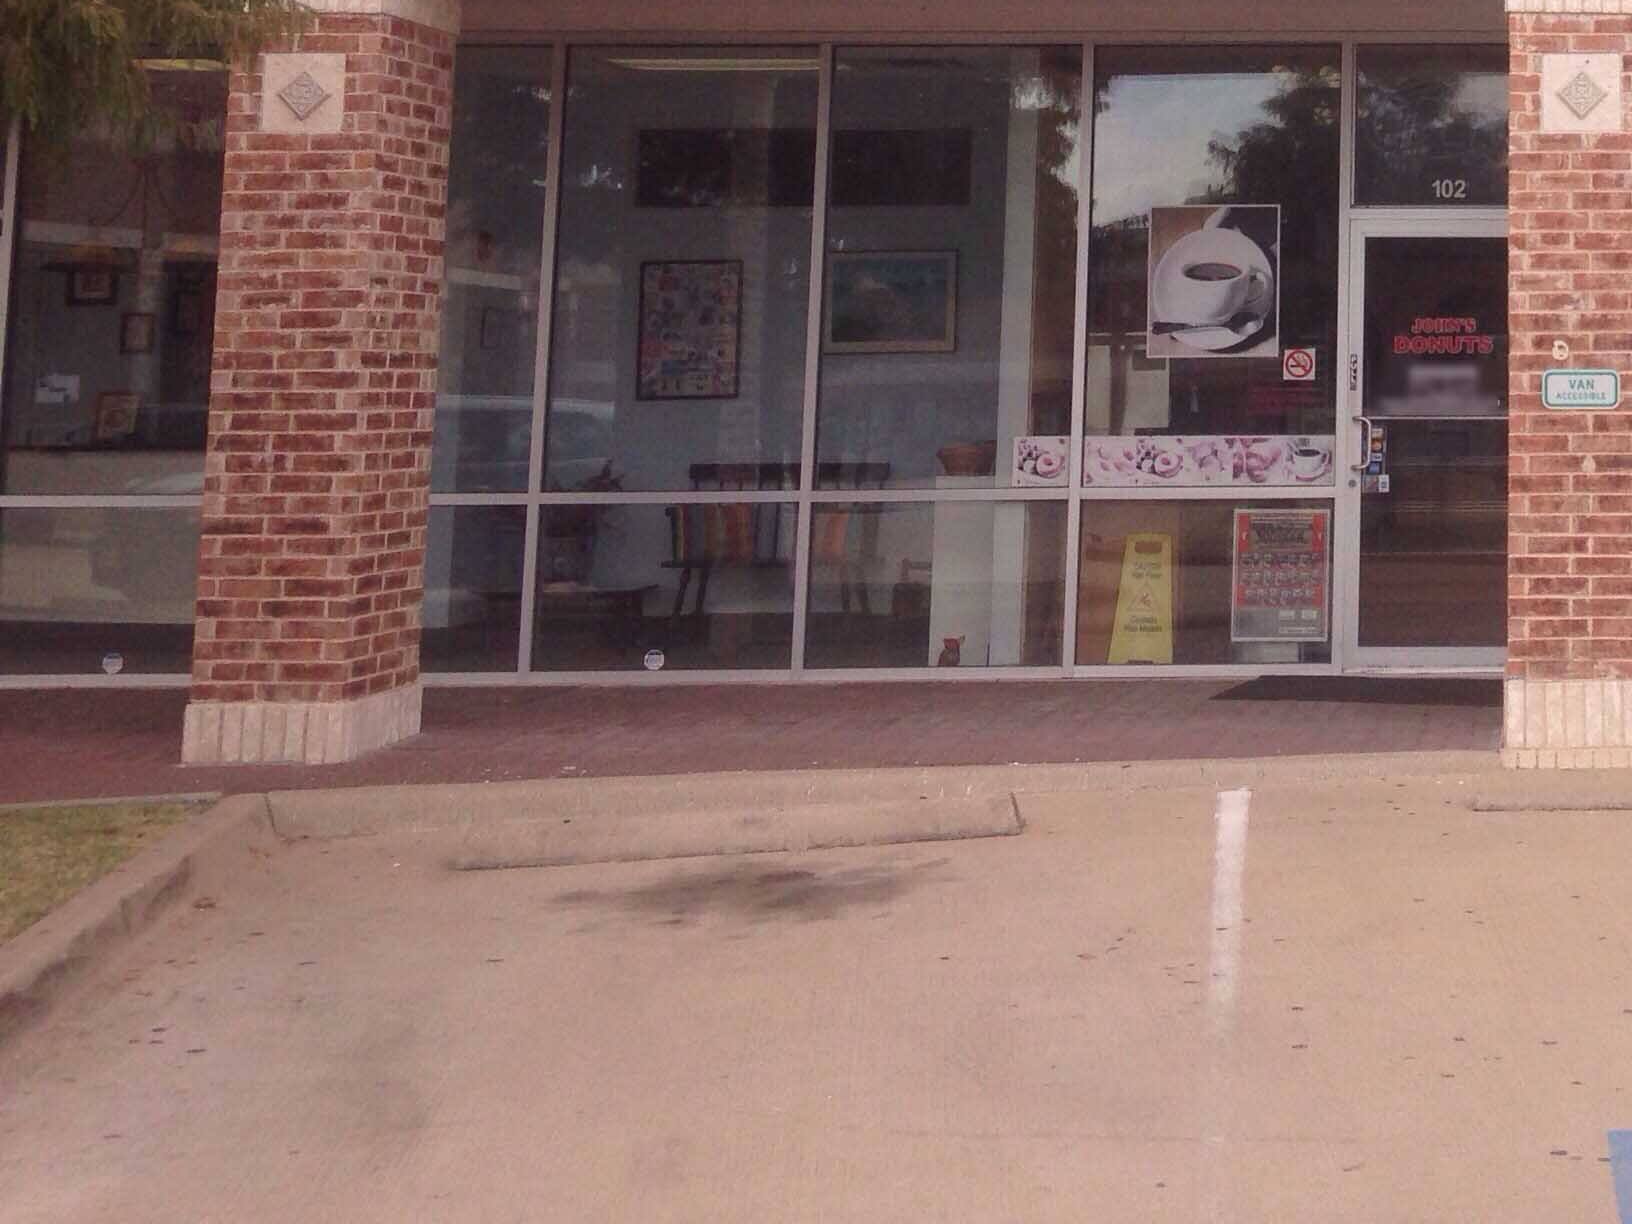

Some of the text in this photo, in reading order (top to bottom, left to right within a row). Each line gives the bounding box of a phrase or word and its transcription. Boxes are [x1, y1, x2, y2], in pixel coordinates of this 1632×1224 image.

[1431, 179, 1467, 199] 102
[1391, 335, 1495, 355] DONUTS
[1568, 379, 1595, 391] VAN
